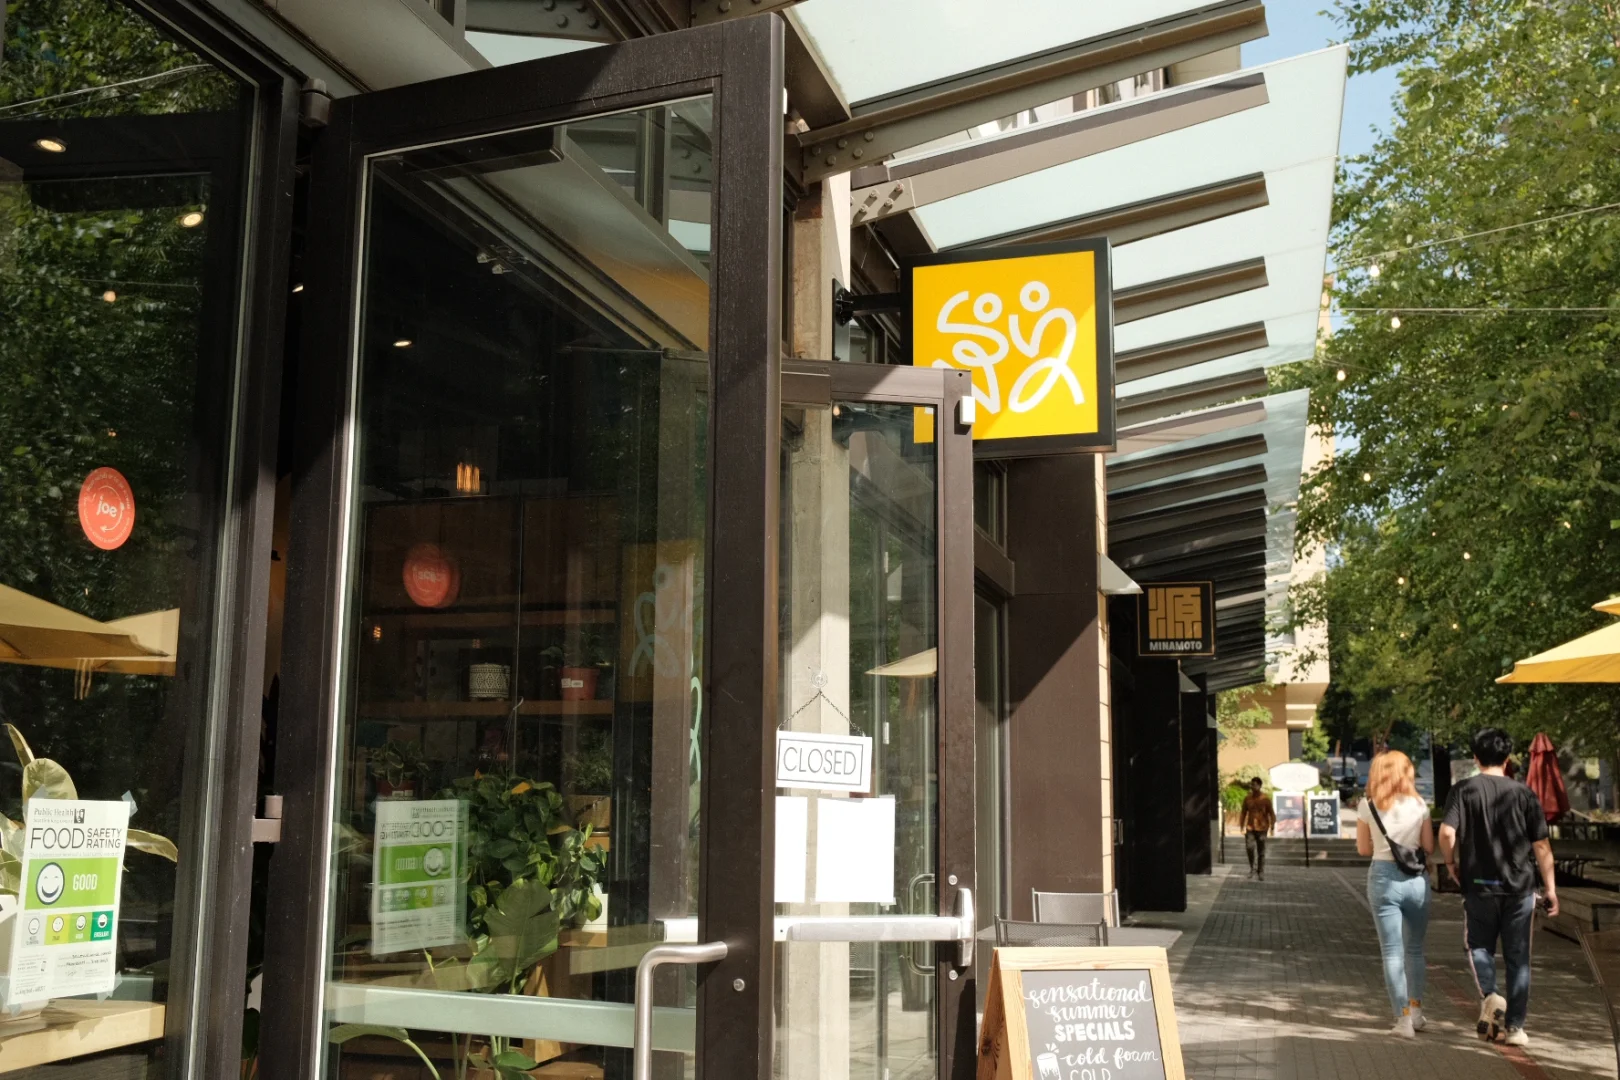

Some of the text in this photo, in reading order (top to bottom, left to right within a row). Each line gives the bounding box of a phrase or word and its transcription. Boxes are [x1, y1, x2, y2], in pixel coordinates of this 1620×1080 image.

[1149, 641, 1203, 651] MINAMOTO
[783, 746, 856, 775] CLOSED
[31, 827, 122, 849] FOOD SAFETY
[86, 839, 121, 849] RATING
[73, 873, 98, 891] GOOD
[1024, 977, 1153, 1008] sensational
[1045, 1004, 1134, 1023] summer
[1054, 1020, 1135, 1042] SPECIALS
[1060, 1047, 1159, 1069] cold foam
